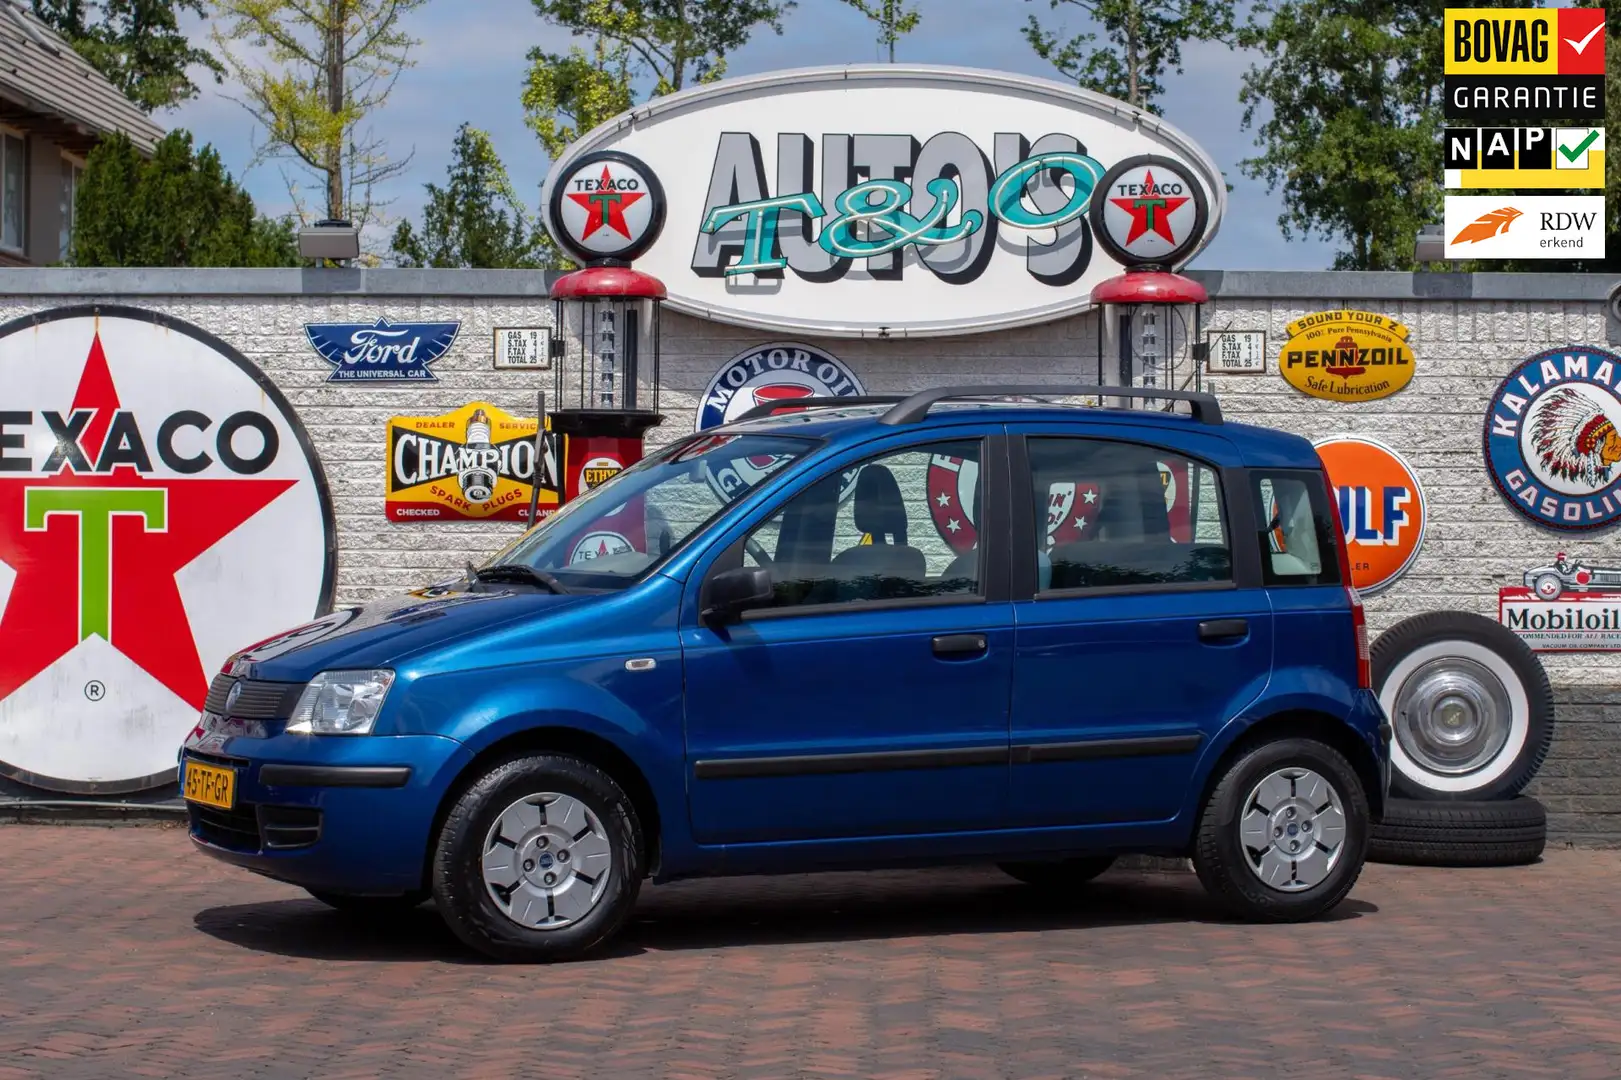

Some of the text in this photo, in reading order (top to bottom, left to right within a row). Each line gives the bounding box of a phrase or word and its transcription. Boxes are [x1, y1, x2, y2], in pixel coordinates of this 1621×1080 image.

[574, 178, 639, 191] TEXACO
[1117, 184, 1182, 196] TEXACO
[1298, 312, 1342, 329] SOUND
[1344, 311, 1383, 325] YOUR
[508, 331, 521, 339] GAS
[1222, 334, 1236, 342] GAS
[1346, 326, 1392, 343] Pennsylvania
[344, 329, 420, 364] Ford
[1222, 342, 1241, 350] S.TAX
[508, 356, 537, 364] TOTAL 25
[1222, 351, 1240, 359] F.TAX
[1287, 347, 1409, 369] PENNZOIL
[1222, 359, 1242, 367] TOTAL
[338, 370, 426, 378] THE UNIVERSAL CAR
[706, 348, 811, 414] MOTOR
[1305, 375, 1390, 395] Safe Lubrication
[1493, 355, 1621, 437] KALAMA
[415, 421, 541, 430] DEALER SERVIC
[0, 410, 279, 475] EXACO
[395, 433, 558, 487] CHAMPION
[586, 469, 617, 483] ETHY
[429, 485, 523, 511] SPARK PLUGS
[396, 508, 440, 516] CHECKED
[1506, 608, 1620, 630] Mobiloil
[186, 767, 229, 803] 45-TF-GR
